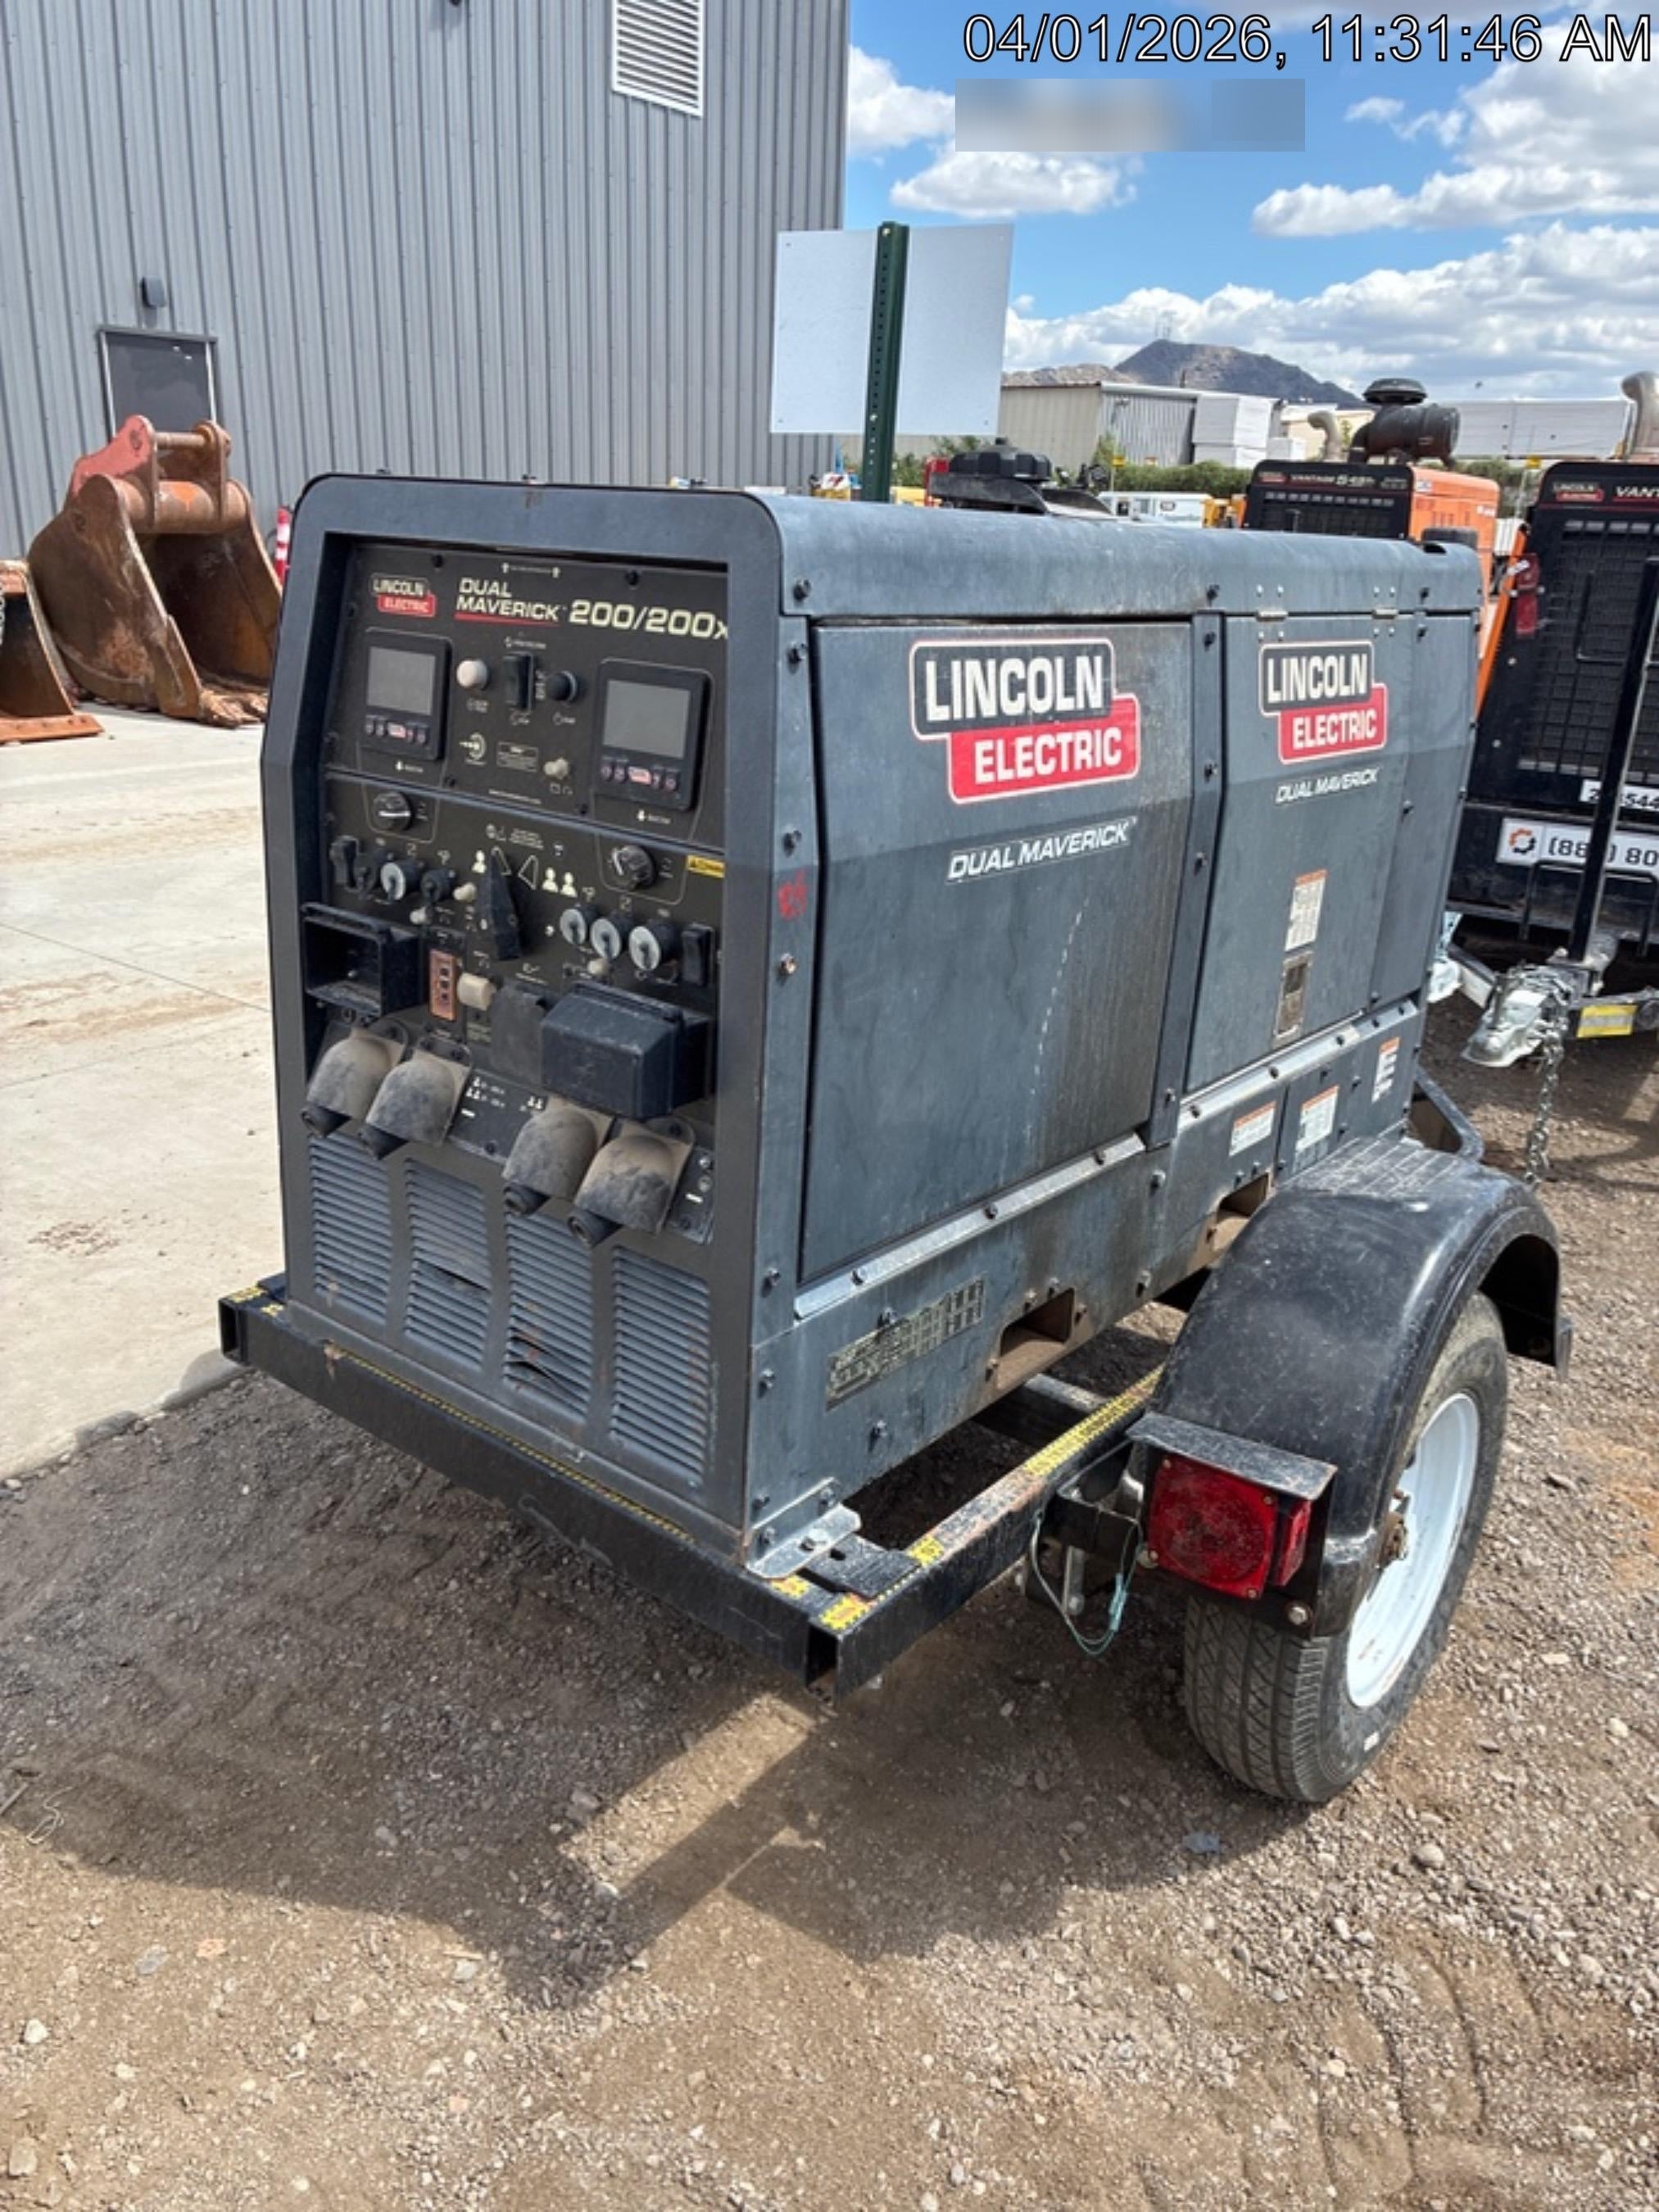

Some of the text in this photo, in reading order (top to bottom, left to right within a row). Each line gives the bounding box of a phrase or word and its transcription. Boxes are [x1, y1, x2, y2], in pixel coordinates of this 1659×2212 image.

[373, 578, 425, 596] LINCOLN
[383, 596, 429, 613] ELECTRIC
[459, 577, 513, 597] DUAL
[456, 595, 559, 621] MAVERICK
[925, 655, 1103, 722] LINCOLN
[1267, 653, 1368, 704] LINCOLN
[1292, 708, 1377, 750] ELECTRIC
[974, 727, 1123, 785] ELECTRIC
[1275, 767, 1380, 803] DUAL MAVERICK
[947, 822, 1131, 880] DUAL MAVERICK
